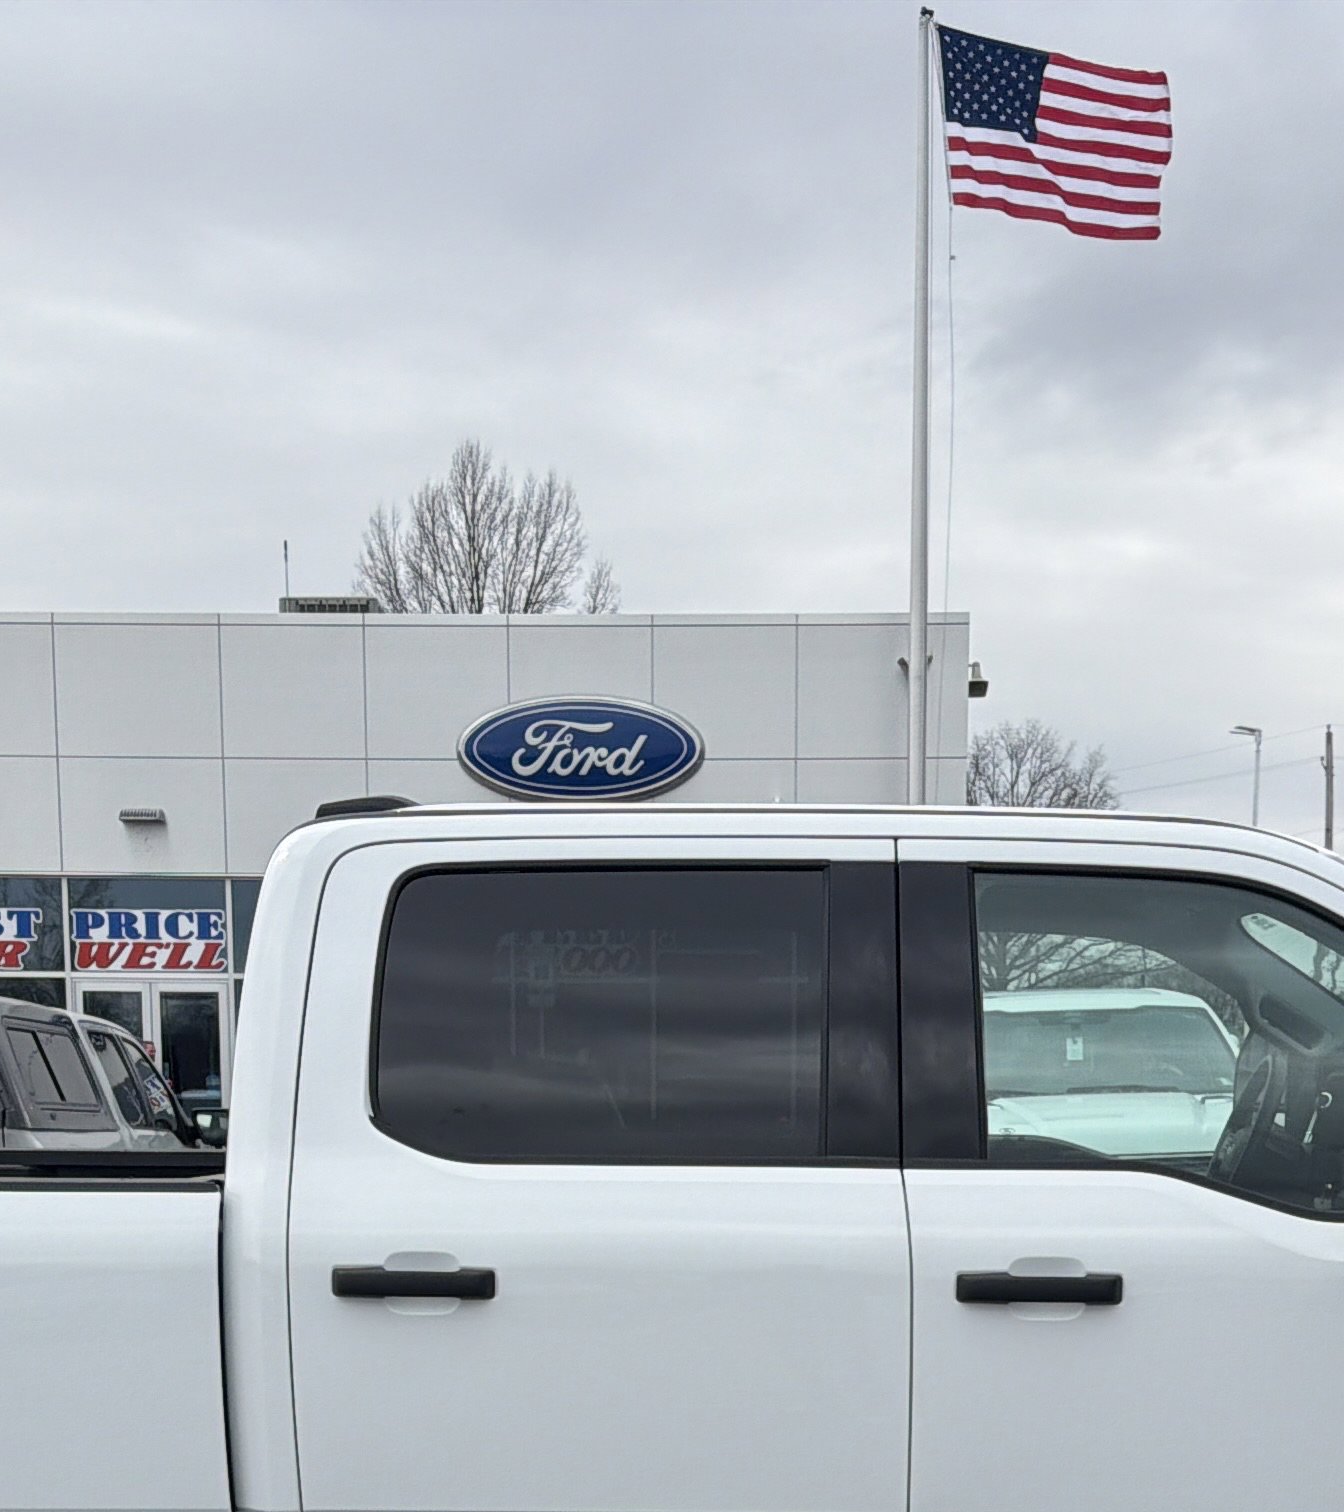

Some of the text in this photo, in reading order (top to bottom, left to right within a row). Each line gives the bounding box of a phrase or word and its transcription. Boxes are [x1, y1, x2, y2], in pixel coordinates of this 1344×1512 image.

[511, 719, 648, 776] Ford
[73, 911, 224, 940] PRICE
[77, 942, 224, 969] WE'LL
